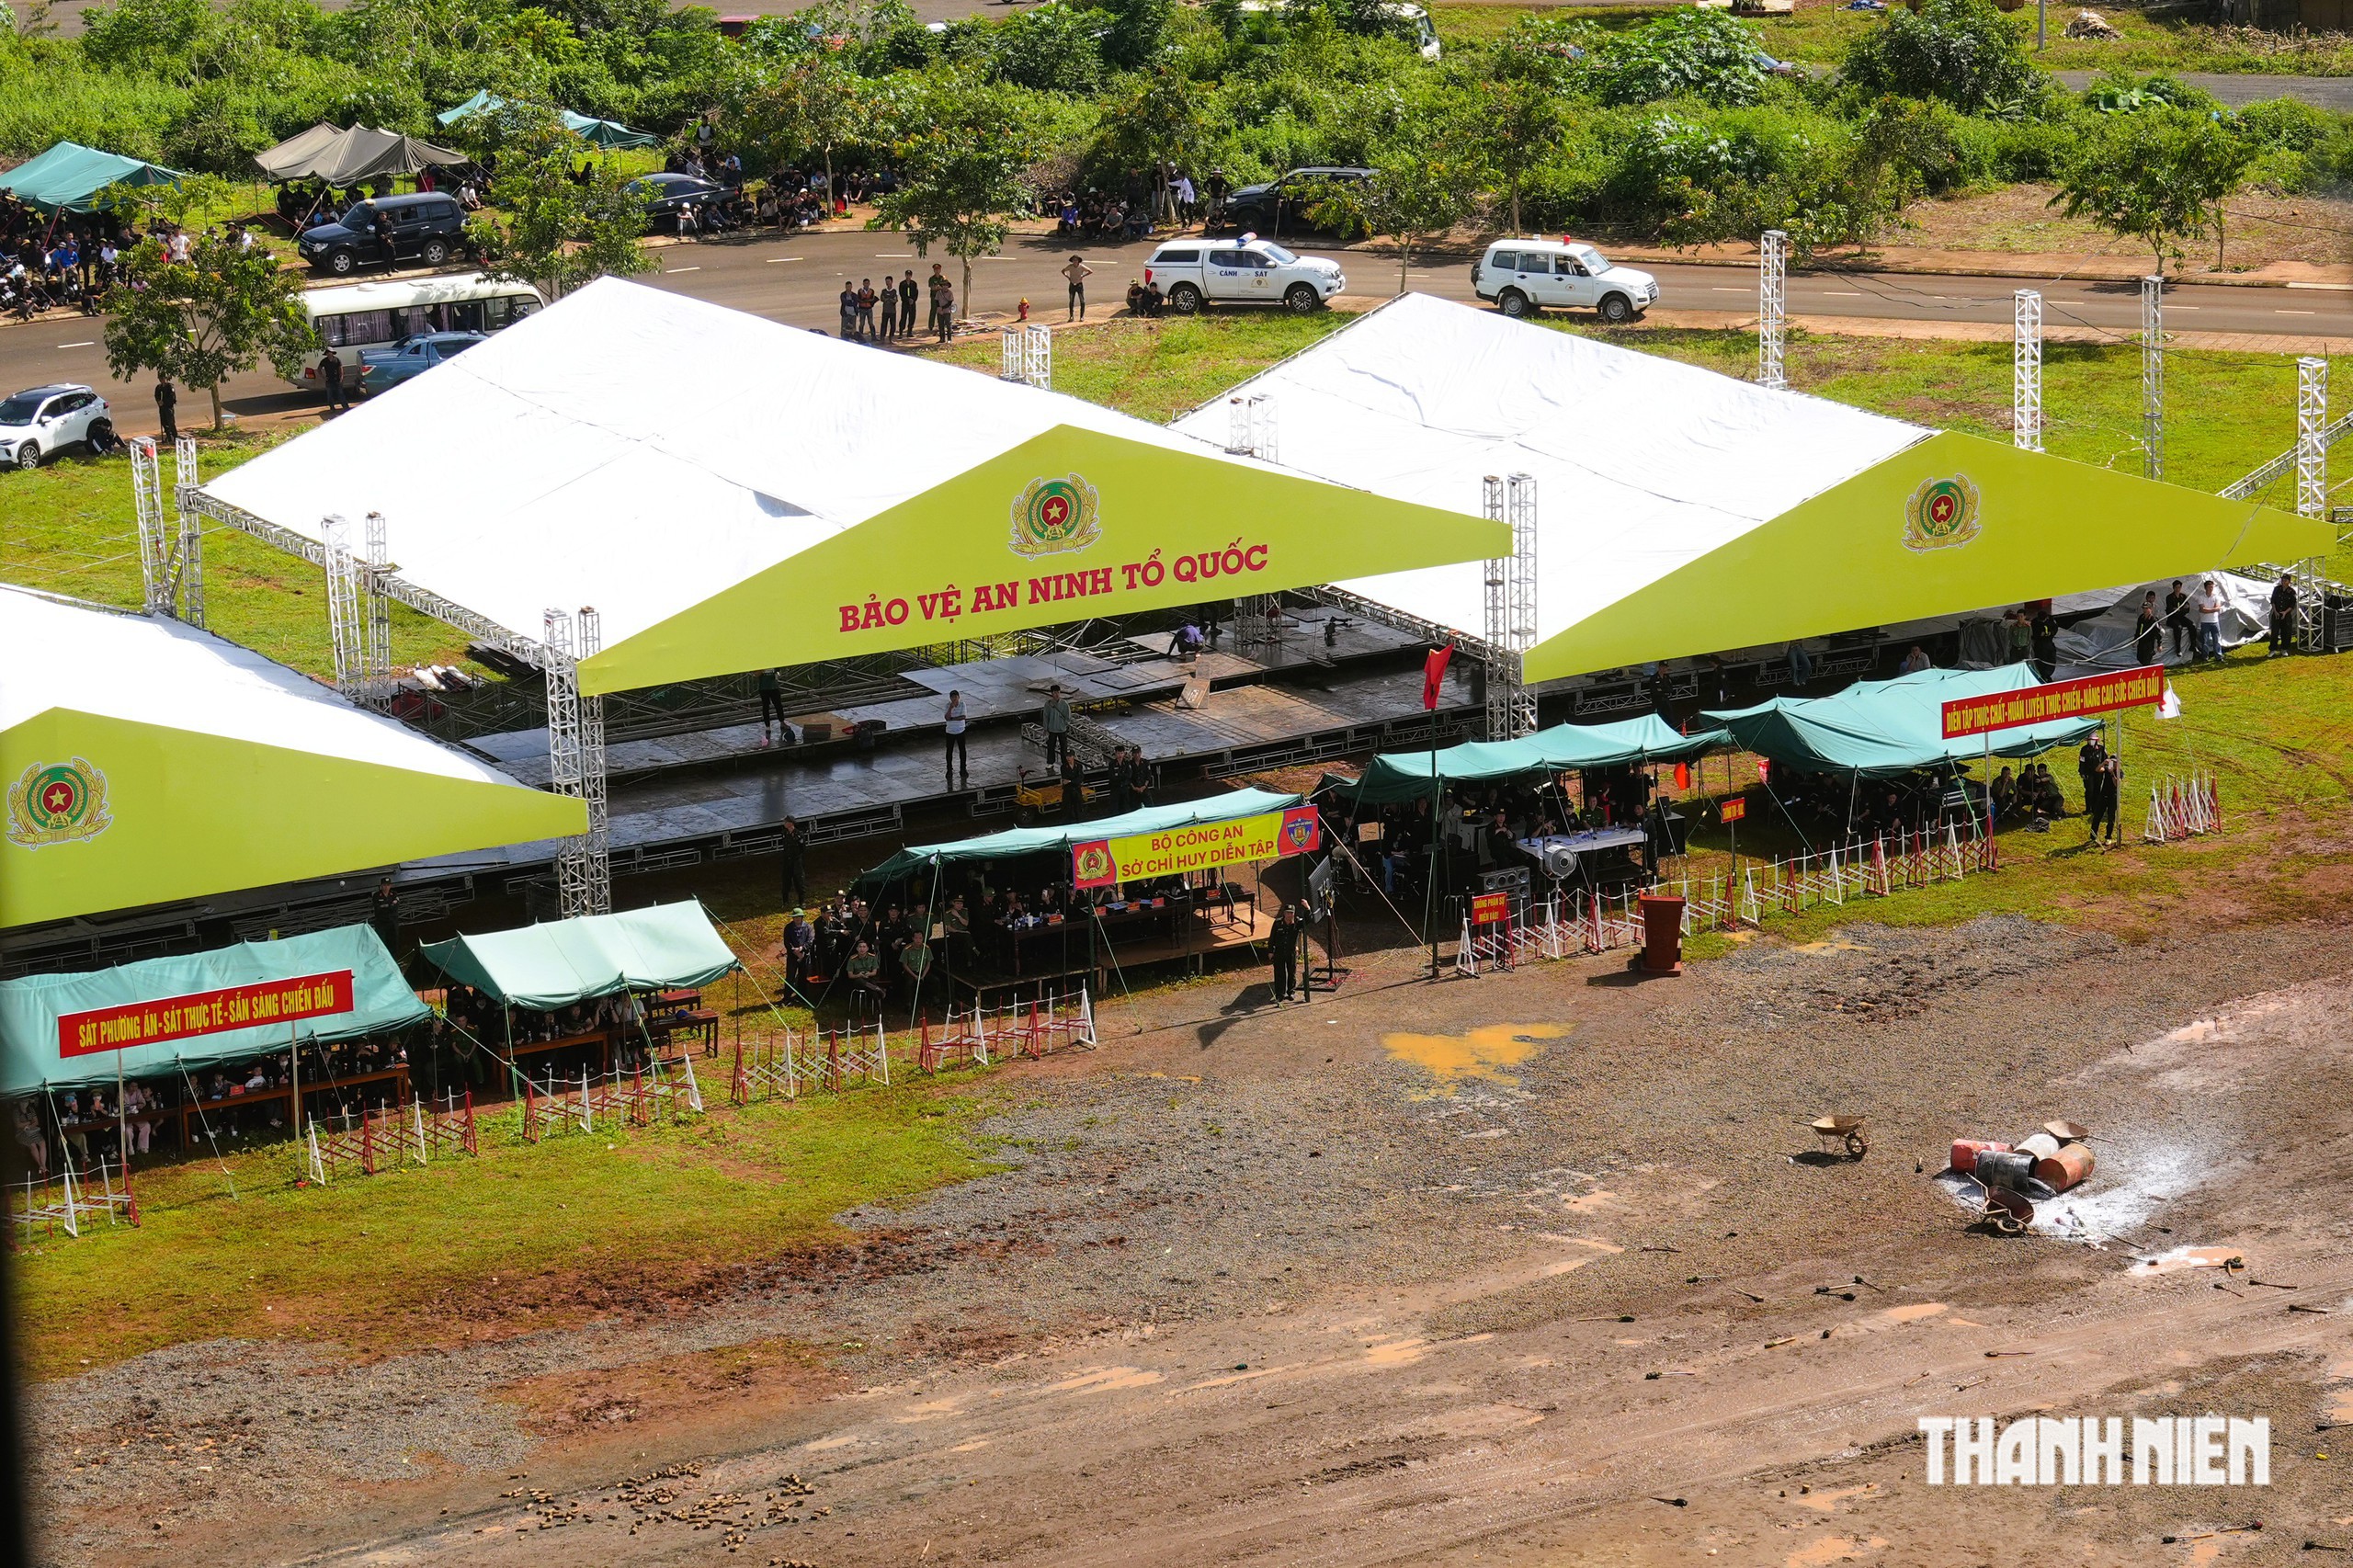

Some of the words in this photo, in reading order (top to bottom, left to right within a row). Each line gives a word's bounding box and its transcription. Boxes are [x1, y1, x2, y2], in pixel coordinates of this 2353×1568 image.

[839, 593, 909, 632] BẢO
[917, 585, 961, 623] VỆ
[971, 581, 1019, 613] AN
[1028, 566, 1113, 605] NINH
[1121, 549, 1165, 588] TỔ
[1173, 537, 1268, 584] QUỐC
[2101, 684, 2114, 706] CAO
[1151, 834, 1172, 853] BỘ
[1176, 830, 1220, 848] CÔNG
[1222, 824, 1244, 839] AN
[1121, 859, 1143, 878] SỞ
[1148, 855, 1173, 873] CHỈ
[1177, 851, 1207, 869] HUY
[1211, 842, 1245, 862] DIỄN
[1248, 839, 1274, 858] TẬP
[79, 1018, 97, 1048] SÁT
[100, 1015, 141, 1044] PHƯƠNG
[184, 1002, 210, 1033] THỰC
[252, 990, 279, 1019] SÀNG
[281, 981, 312, 1015] CHIẾN
[313, 977, 334, 1010] ĐẤU
